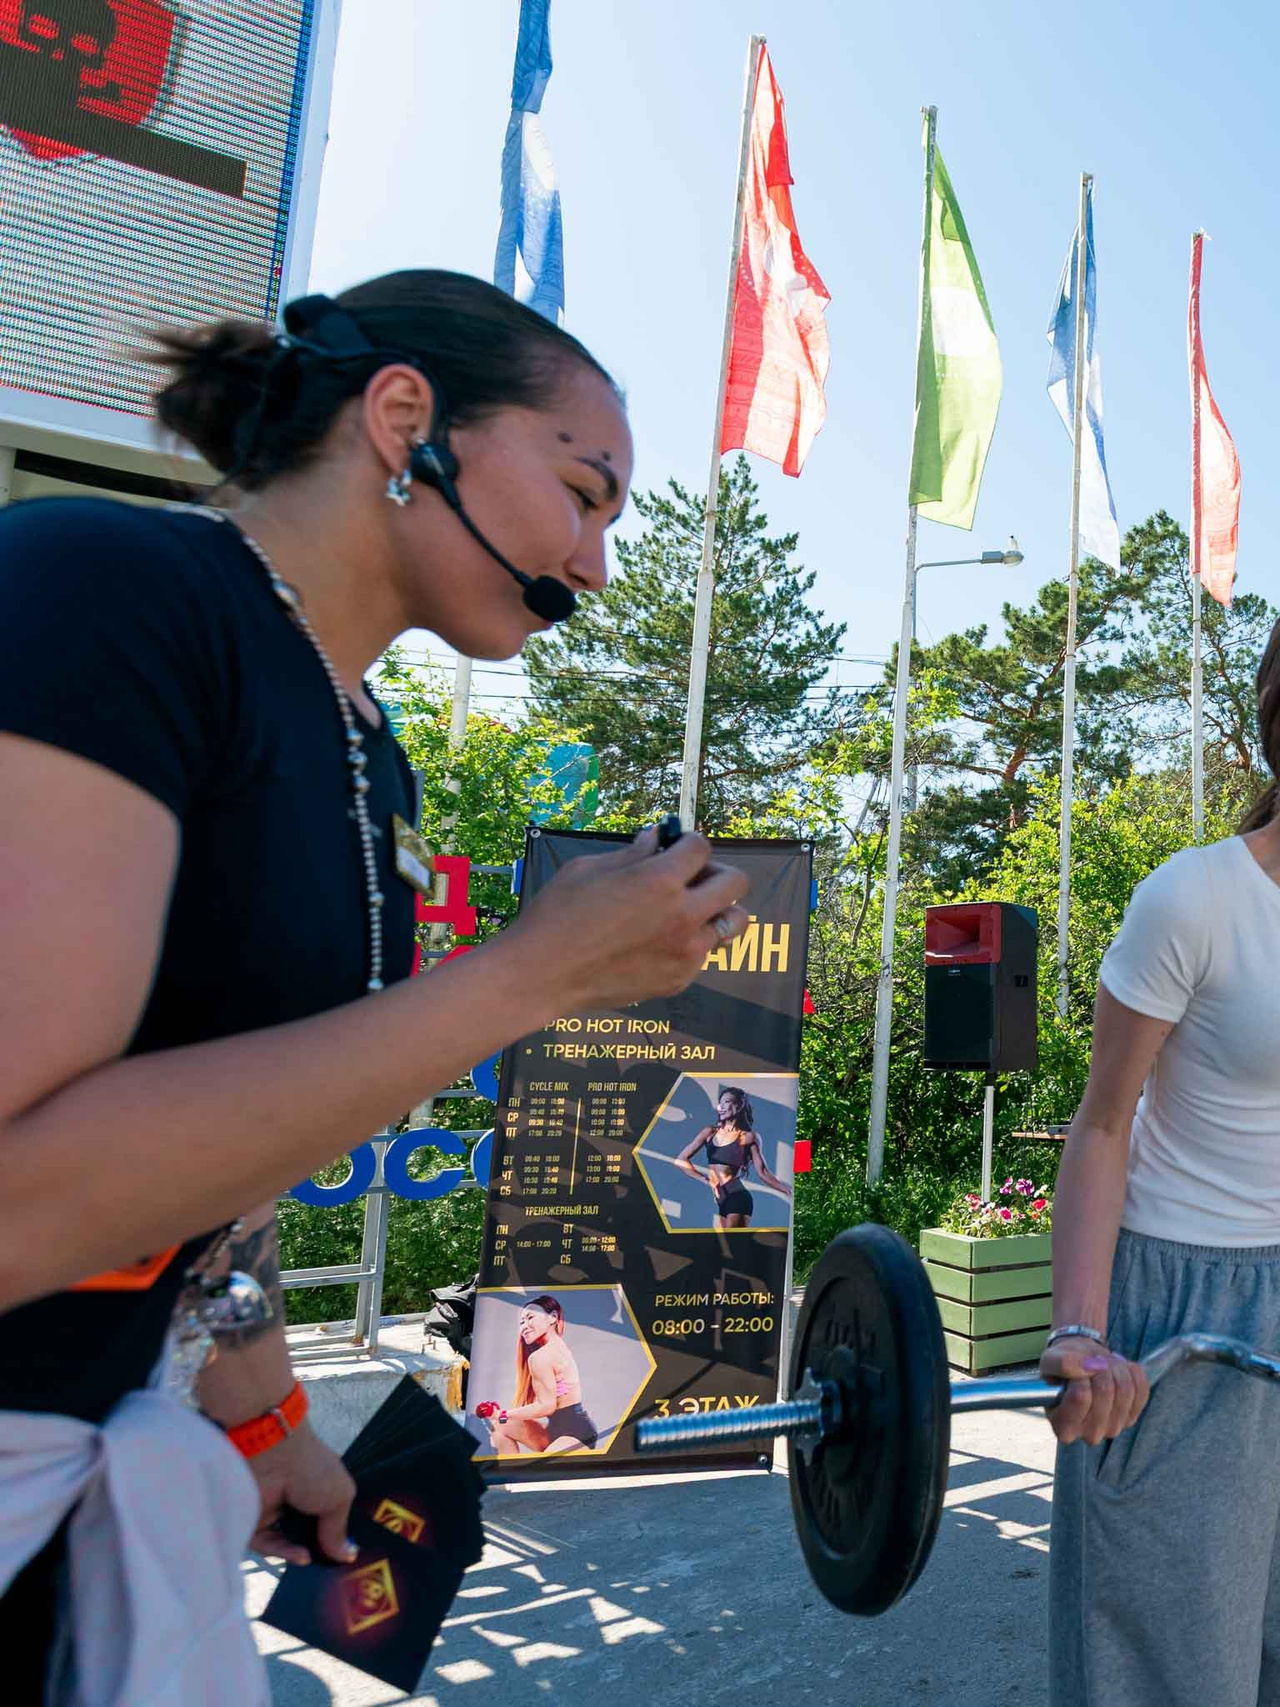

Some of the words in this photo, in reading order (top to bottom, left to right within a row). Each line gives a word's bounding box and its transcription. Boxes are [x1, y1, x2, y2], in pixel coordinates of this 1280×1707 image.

[545, 1019, 581, 1033] PRO
[586, 1019, 623, 1033] HOT
[628, 1019, 670, 1034] IRON
[543, 1042, 676, 1060] ТРЕНАЖЕРНЫЙ
[681, 1046, 715, 1060] ЗАЛ
[530, 1082, 552, 1091] CYCLE
[554, 1082, 569, 1091] MIX
[588, 1082, 602, 1091] PRO
[603, 1082, 618, 1091] HOT
[620, 1082, 636, 1092] IRON
[508, 1098, 520, 1107] ПН
[508, 1112, 519, 1122] СР
[506, 1127, 517, 1137] ПТ
[503, 1156, 514, 1165] ВТ
[502, 1171, 513, 1180] ЧТ
[500, 1186, 511, 1195] СБ
[525, 1205, 581, 1216] ТРЕНАЖЕРНЫЙ
[583, 1205, 599, 1215] ЗАЛ
[496, 1225, 509, 1234] ПН
[563, 1224, 574, 1234] ВТ
[495, 1240, 506, 1250] СР
[562, 1239, 572, 1249] ЧТ
[494, 1256, 505, 1266] ПТ
[560, 1254, 571, 1264] СБ
[655, 1294, 709, 1307] РЕЖИМ
[713, 1292, 774, 1305] РАБОТЫ:
[652, 1319, 705, 1335] 08:00
[724, 1317, 774, 1333] 22:00
[653, 1399, 671, 1420] 3
[678, 1395, 760, 1416] ЭТАЖ
